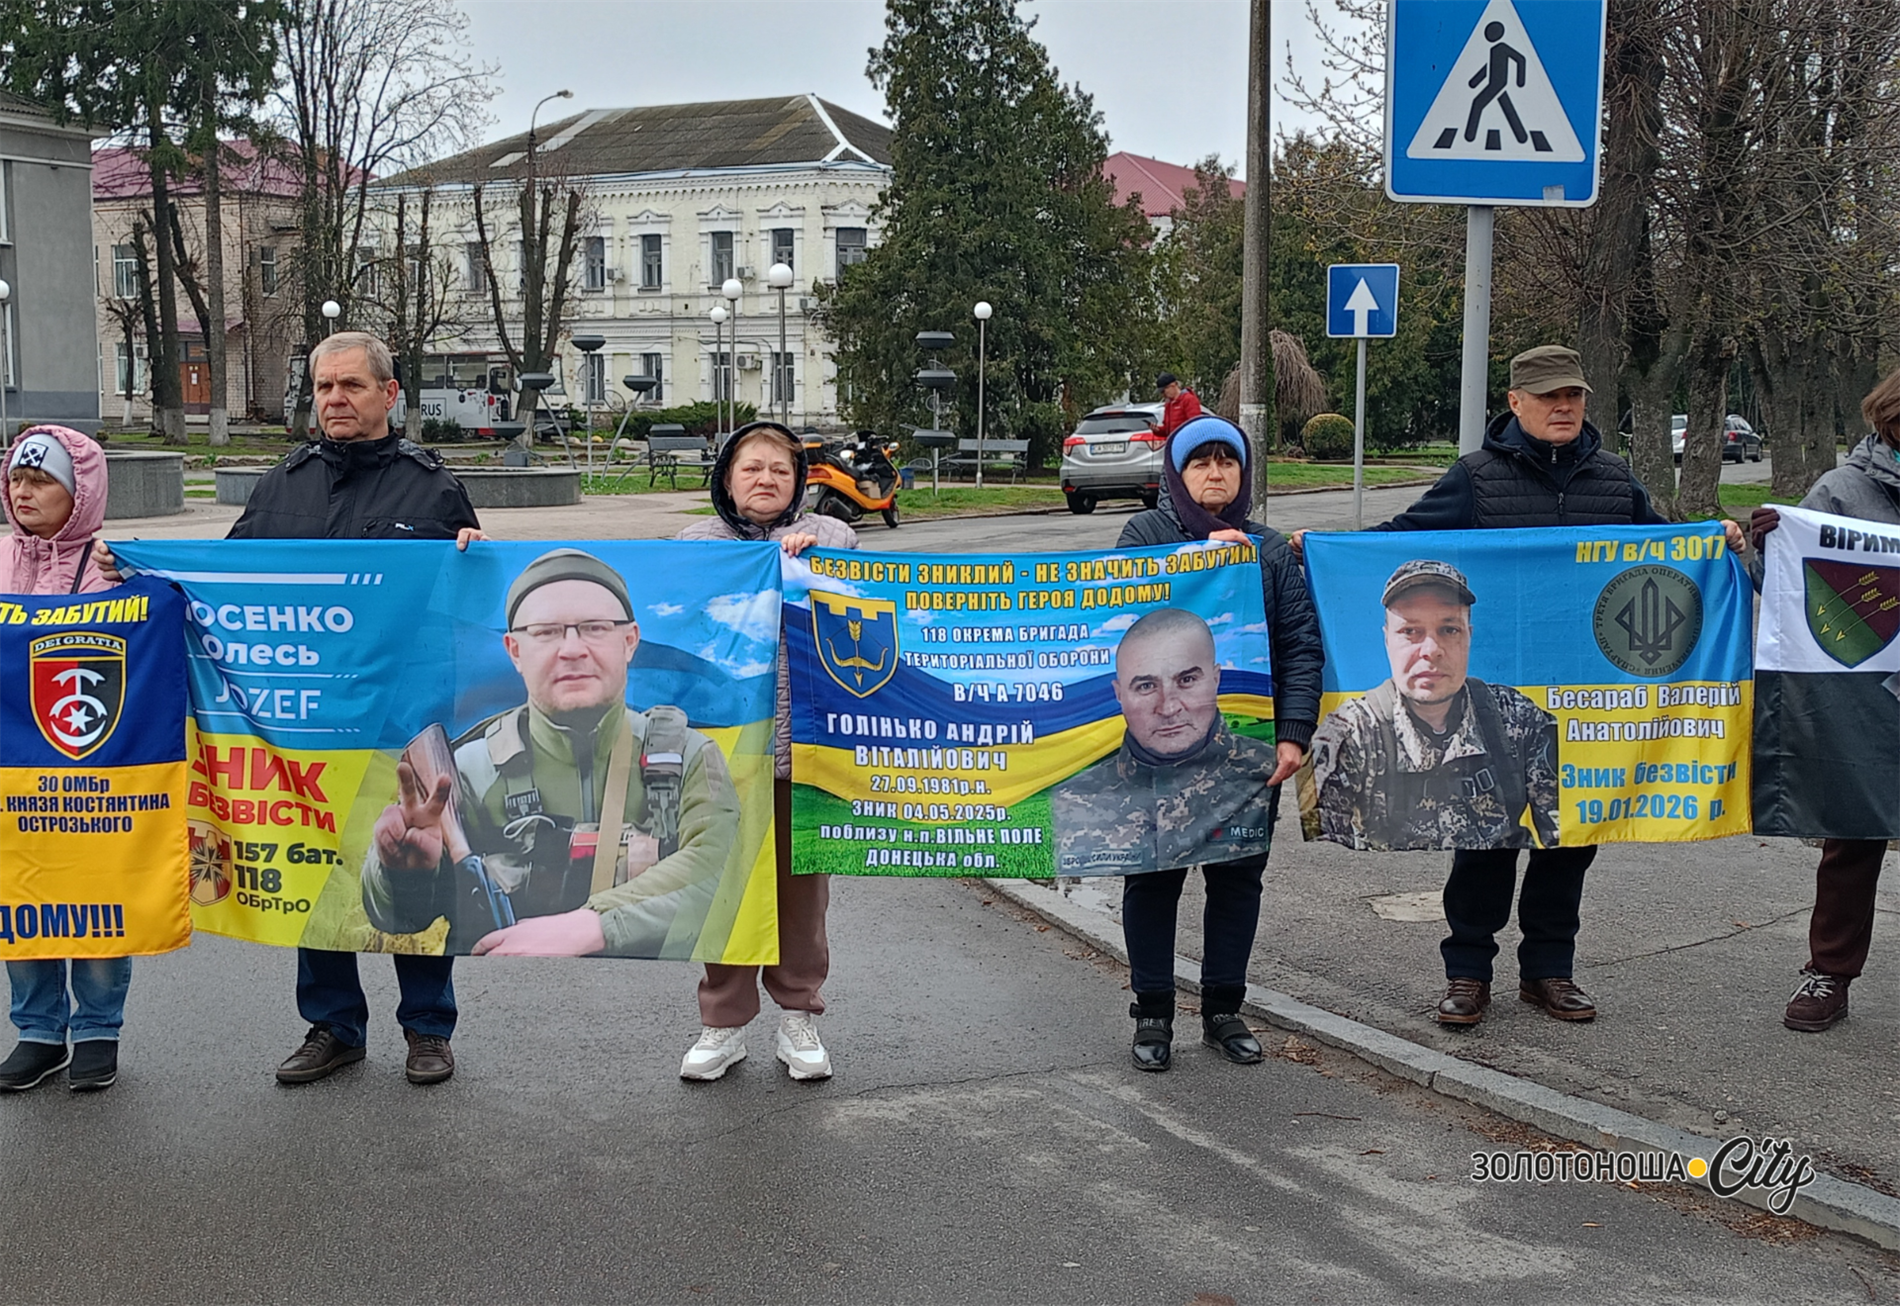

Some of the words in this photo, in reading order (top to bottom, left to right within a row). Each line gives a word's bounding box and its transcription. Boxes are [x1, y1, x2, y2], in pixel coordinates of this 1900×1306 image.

[1575, 540, 1619, 563] НГУ
[1623, 539, 1665, 562] в/ч
[1670, 535, 1726, 561] 3017
[810, 556, 911, 584] БЕЗВІСТИ
[917, 561, 1014, 584] ЗНИКЛИЙ
[1035, 563, 1060, 583] НЕ
[1066, 558, 1159, 582] ЗНАЧИТЬ
[1606, 568, 1649, 596] БРИГАДА
[31, 595, 149, 625] ЗАБУТИЙ!
[906, 591, 1012, 611] ПОВЕРНІТЬ
[1018, 590, 1074, 610] ГЕРОЯ
[1081, 583, 1170, 610] ДОДОМУ!
[186, 600, 354, 633] ОСЕНКО
[34, 638, 61, 652] DEI
[63, 636, 122, 650] GRATIA
[921, 627, 947, 642] 118
[953, 627, 1014, 642] ОКРЕМА
[1019, 624, 1089, 642] БРИГАДА
[202, 634, 320, 666] Олесь
[904, 651, 1034, 669] ТЕРИТОРІАЛЬНОЇ
[1038, 650, 1110, 668] ОБОРОНИ
[215, 674, 321, 719] JOZEF
[953, 684, 990, 702] В/Ч
[997, 684, 1009, 702] А
[1014, 683, 1063, 702] 7046
[1547, 686, 1648, 710] Бесараб
[1657, 682, 1741, 708] Валерій
[827, 713, 937, 739] ГОЛІНЬКО
[946, 720, 1034, 746] АНДРІЙ
[1566, 715, 1725, 742] Анатолійович
[855, 745, 1008, 770] ВІТАЛІЙОВИЧ
[38, 776, 58, 792] 30
[63, 777, 110, 794] ОМБр
[871, 775, 992, 796] 27.09.1981р.н.
[1561, 763, 1626, 789] Зник
[1634, 760, 1737, 785] безвісти
[6, 796, 59, 813] КНЯЗЯ
[63, 793, 170, 813] КОСТЯНТИНА
[187, 781, 337, 834] БЕЗВІСТИ
[852, 800, 898, 818] ЗНИК
[903, 803, 1012, 822] 04.05.2025р.
[1576, 794, 1698, 824] 19.01.2026
[1709, 799, 1726, 821] р.
[18, 816, 133, 833] ОСТРОЗЬКОГО
[820, 825, 898, 842] поблизу
[1001, 828, 1043, 844] ПОЛЕ
[1230, 826, 1265, 838] MEDIC
[234, 841, 279, 863] 157
[286, 842, 344, 865] бат.
[865, 849, 957, 868] ДОНЕЦЬКА
[963, 853, 1001, 868] обл.
[235, 864, 282, 894] 118
[236, 892, 311, 914] ОБрТрО
